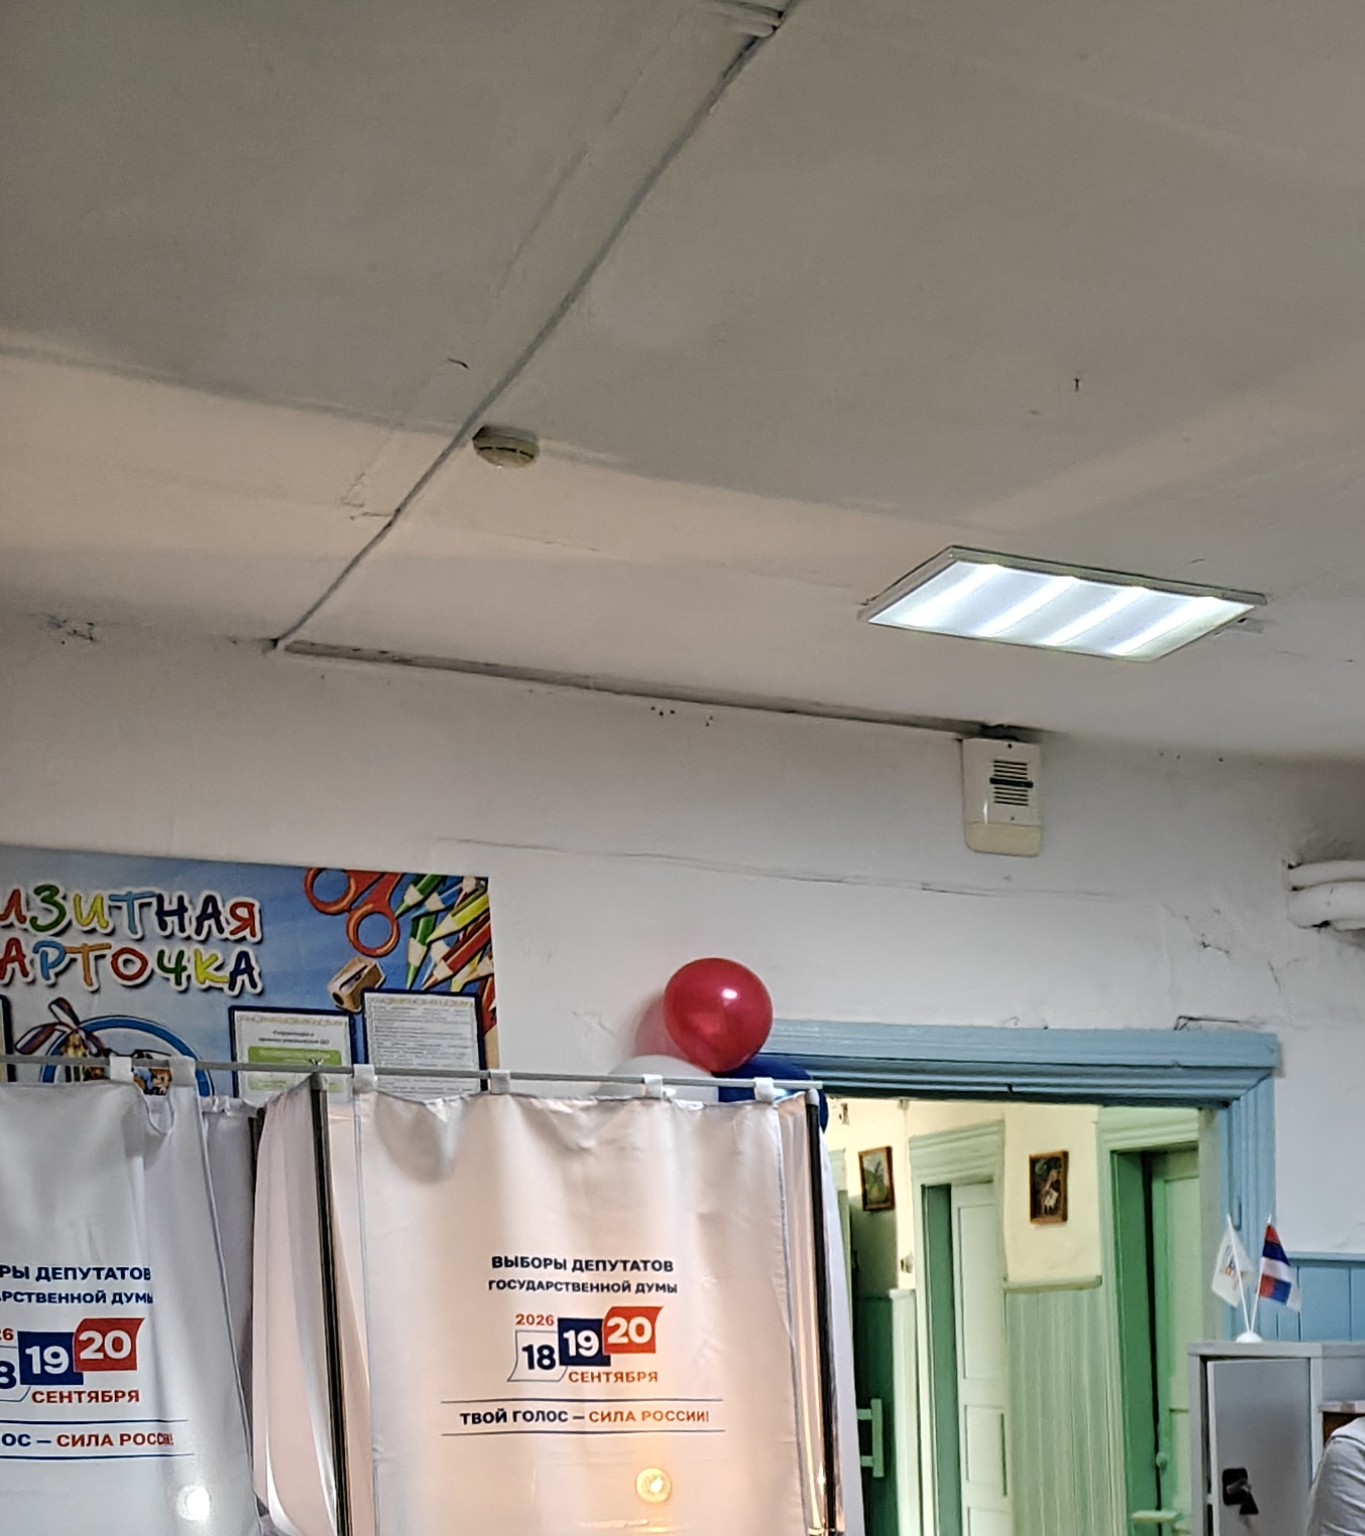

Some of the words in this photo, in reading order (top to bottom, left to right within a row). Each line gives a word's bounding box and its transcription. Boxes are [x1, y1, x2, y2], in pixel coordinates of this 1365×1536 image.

[491, 1255, 567, 1271] ВЫБОРЫ
[571, 1258, 674, 1273] ДЕПУТАТОВ
[35, 1266, 151, 1282] ДЕПУТАТОВ
[488, 1279, 631, 1294] ГОСУДАРСТВЕННОЙ
[635, 1282, 678, 1294] ДУМЫ
[0, 1290, 107, 1304] РСТВЕННОЙ
[515, 1313, 555, 1326] 2026
[522, 1344, 556, 1370] 18
[563, 1329, 600, 1357] 19
[607, 1316, 652, 1344] 20
[25, 1345, 70, 1375] 19
[78, 1329, 132, 1360] 20
[568, 1370, 659, 1383] СЕНТЯБРЯ
[31, 1389, 140, 1404] СЕНТЯБРЯ
[460, 1408, 508, 1425] ТВОЙ
[512, 1410, 569, 1423] ГОЛОС
[589, 1410, 636, 1423] СИЛА
[642, 1410, 709, 1423] РОССИИ!
[56, 1434, 114, 1447] СИЛА
